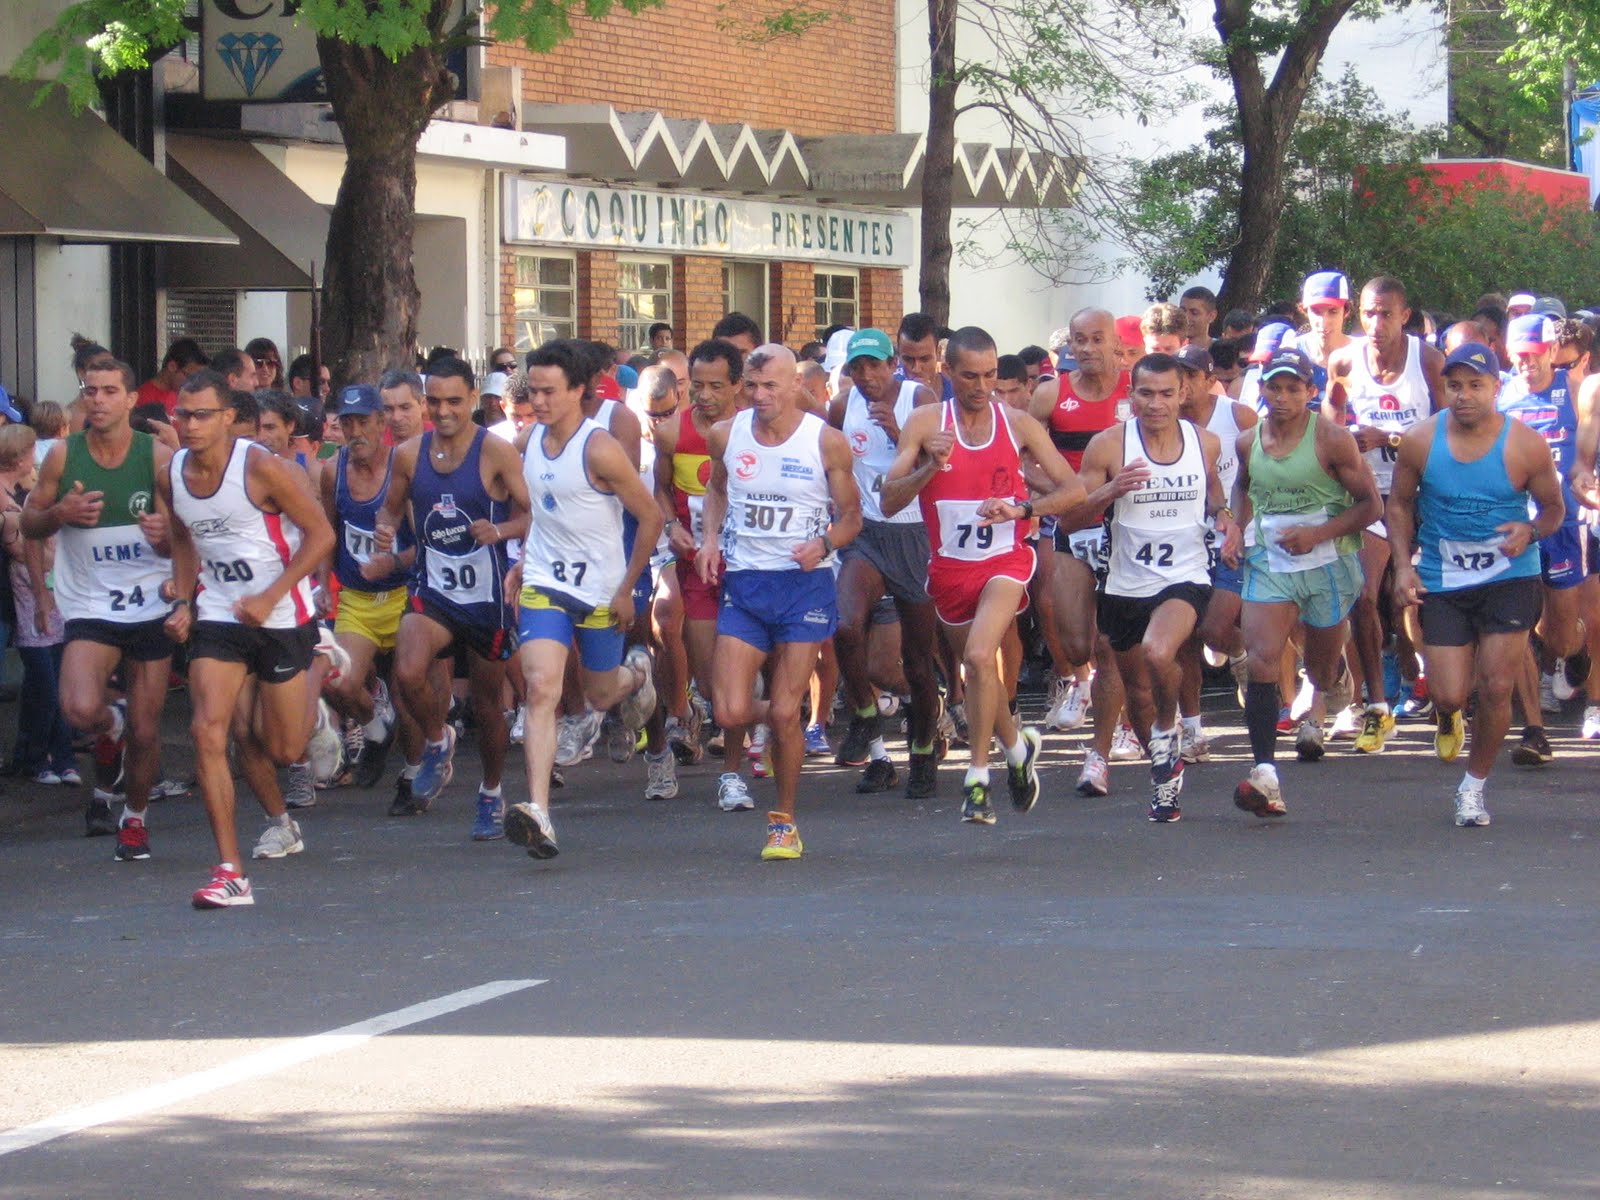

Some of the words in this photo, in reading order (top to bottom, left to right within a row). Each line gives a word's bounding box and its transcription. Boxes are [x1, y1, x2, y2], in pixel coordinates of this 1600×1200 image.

[560, 187, 729, 247] COQUINHO
[771, 211, 893, 256] PRESENTES
[1144, 473, 1199, 490] EMP
[1158, 491, 1177, 502] AUTO
[744, 503, 794, 533] 307
[1150, 508, 1178, 519] SALES
[956, 523, 993, 549] 79
[92, 542, 141, 562] LEME
[1074, 538, 1098, 560] 51
[1135, 543, 1174, 567] 42
[441, 564, 476, 591] 30
[551, 560, 587, 587] 87
[109, 585, 145, 611] 24
